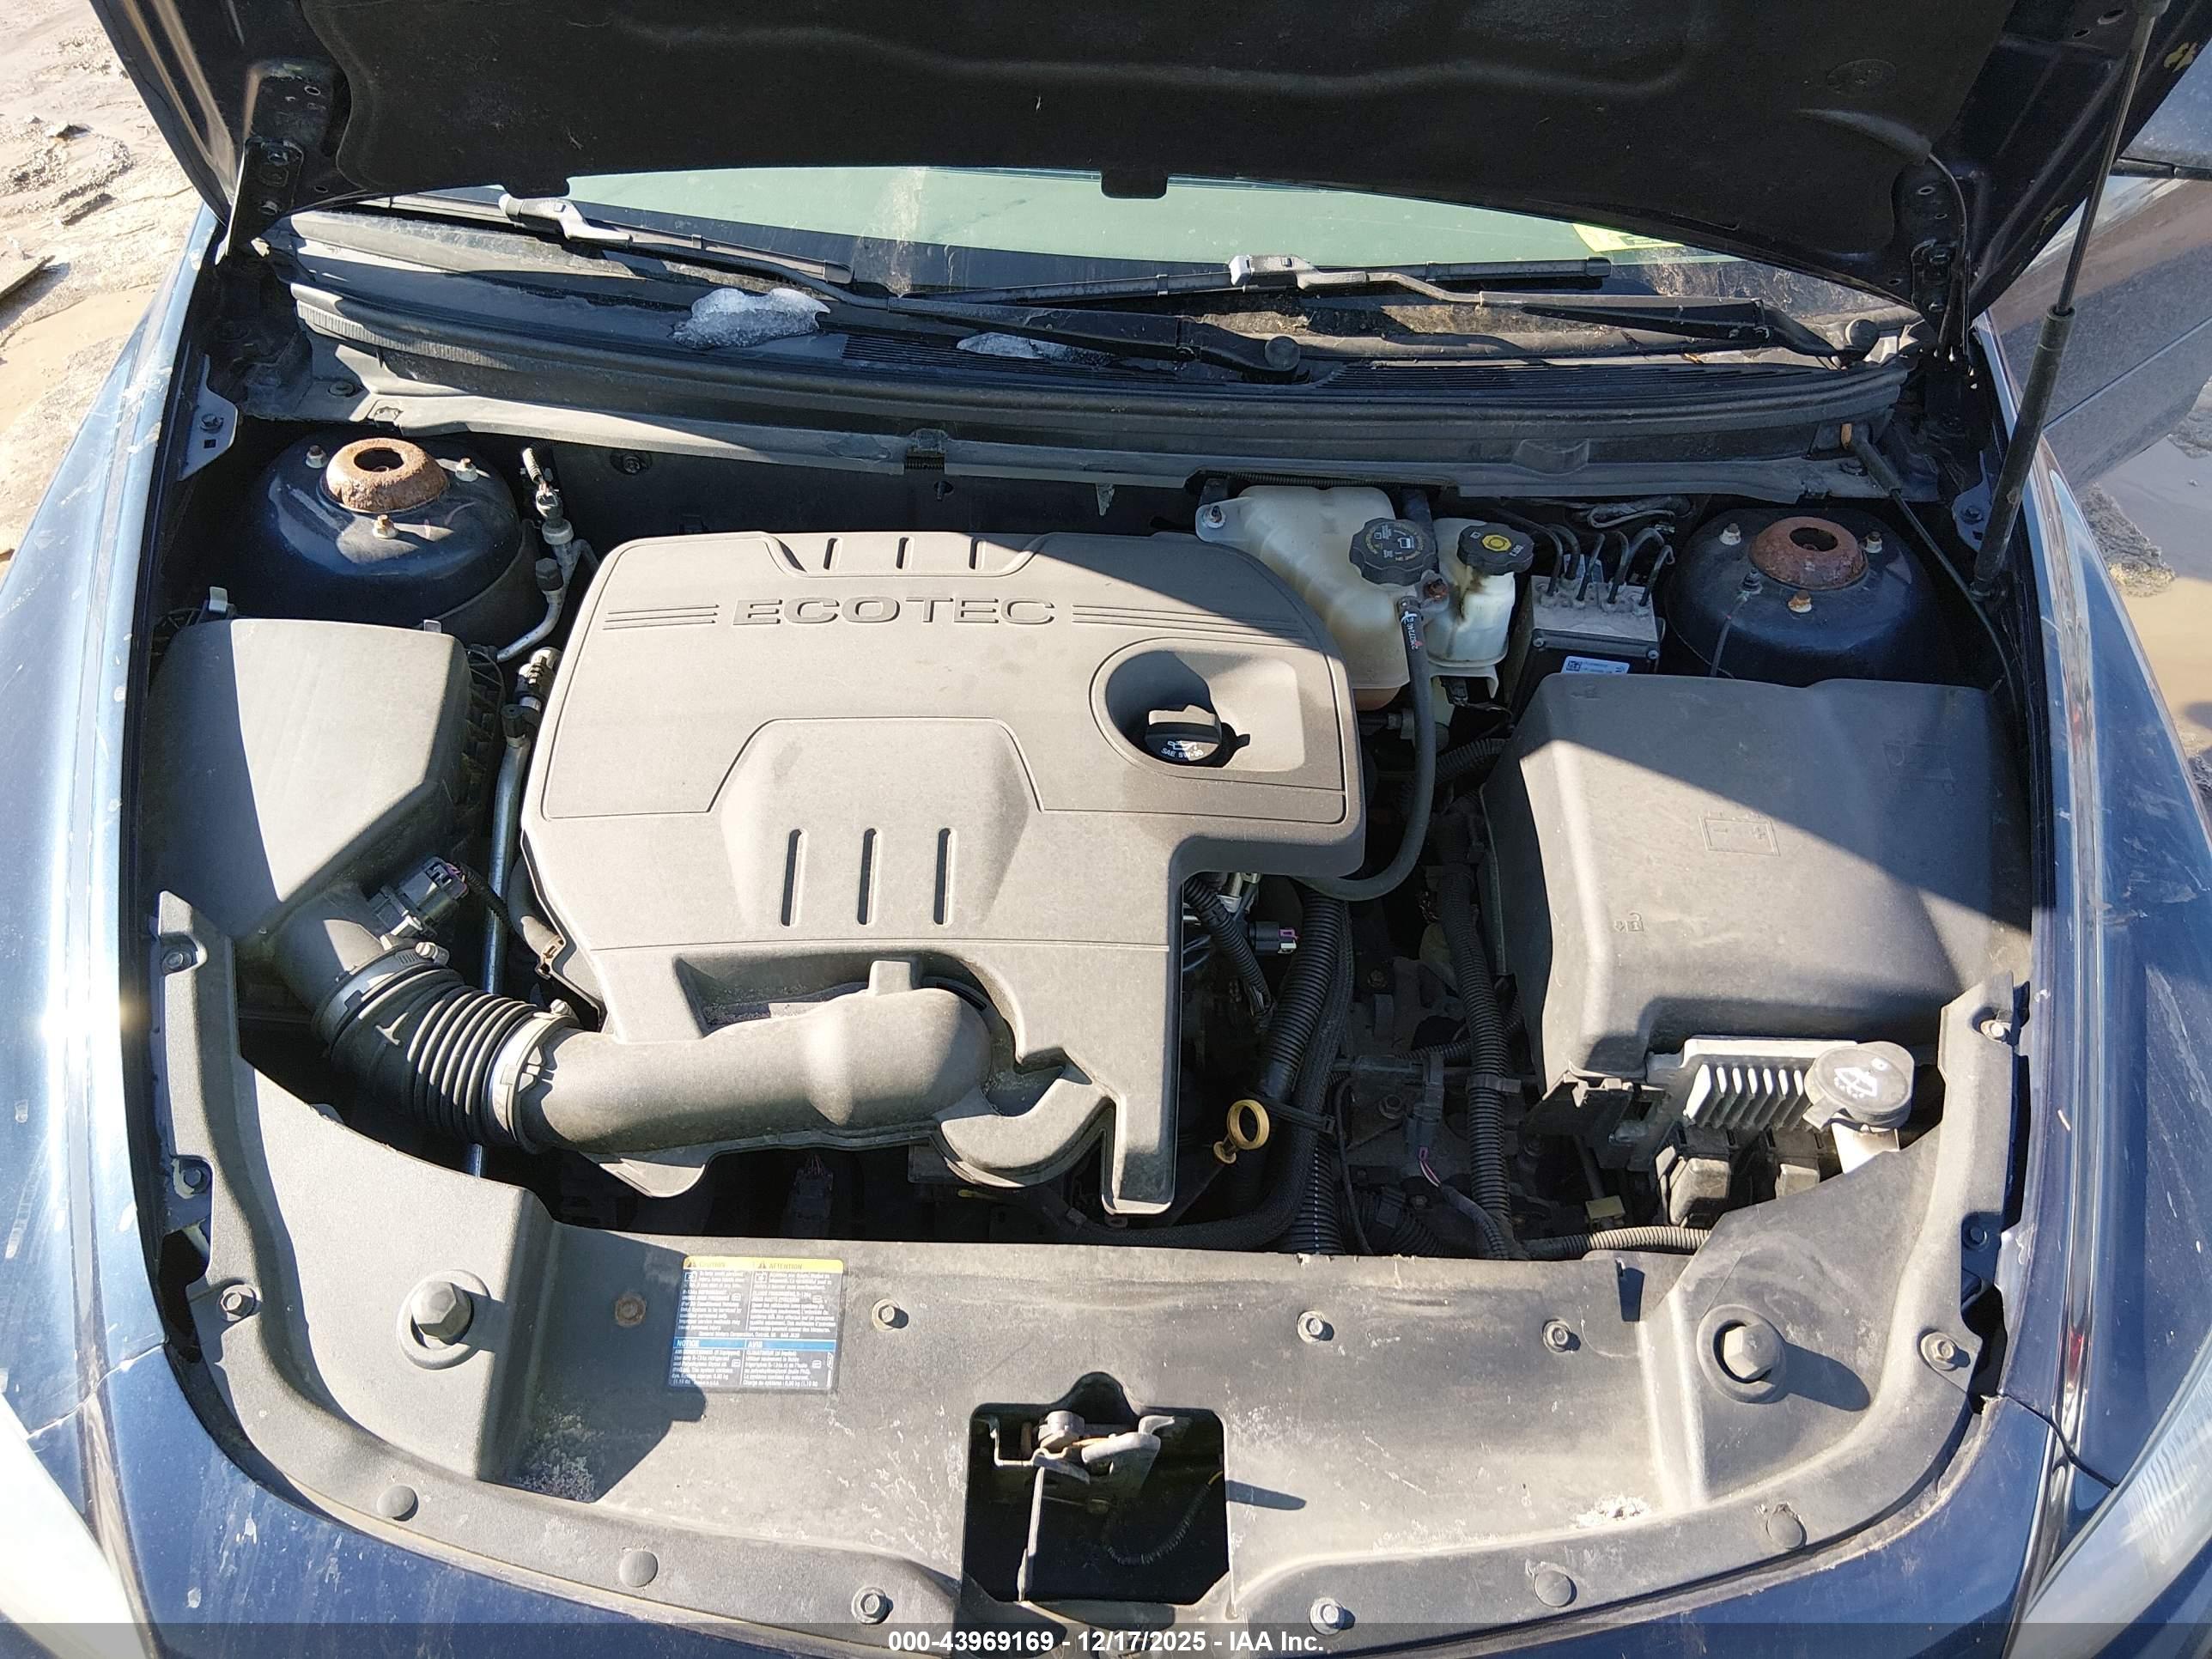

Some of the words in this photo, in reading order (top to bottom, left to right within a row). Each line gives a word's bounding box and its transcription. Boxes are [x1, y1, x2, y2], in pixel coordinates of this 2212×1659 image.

[732, 596, 1056, 625] ECOTEC
[1160, 747, 1176, 757] SAE
[676, 1339, 701, 1347] NOTICE
